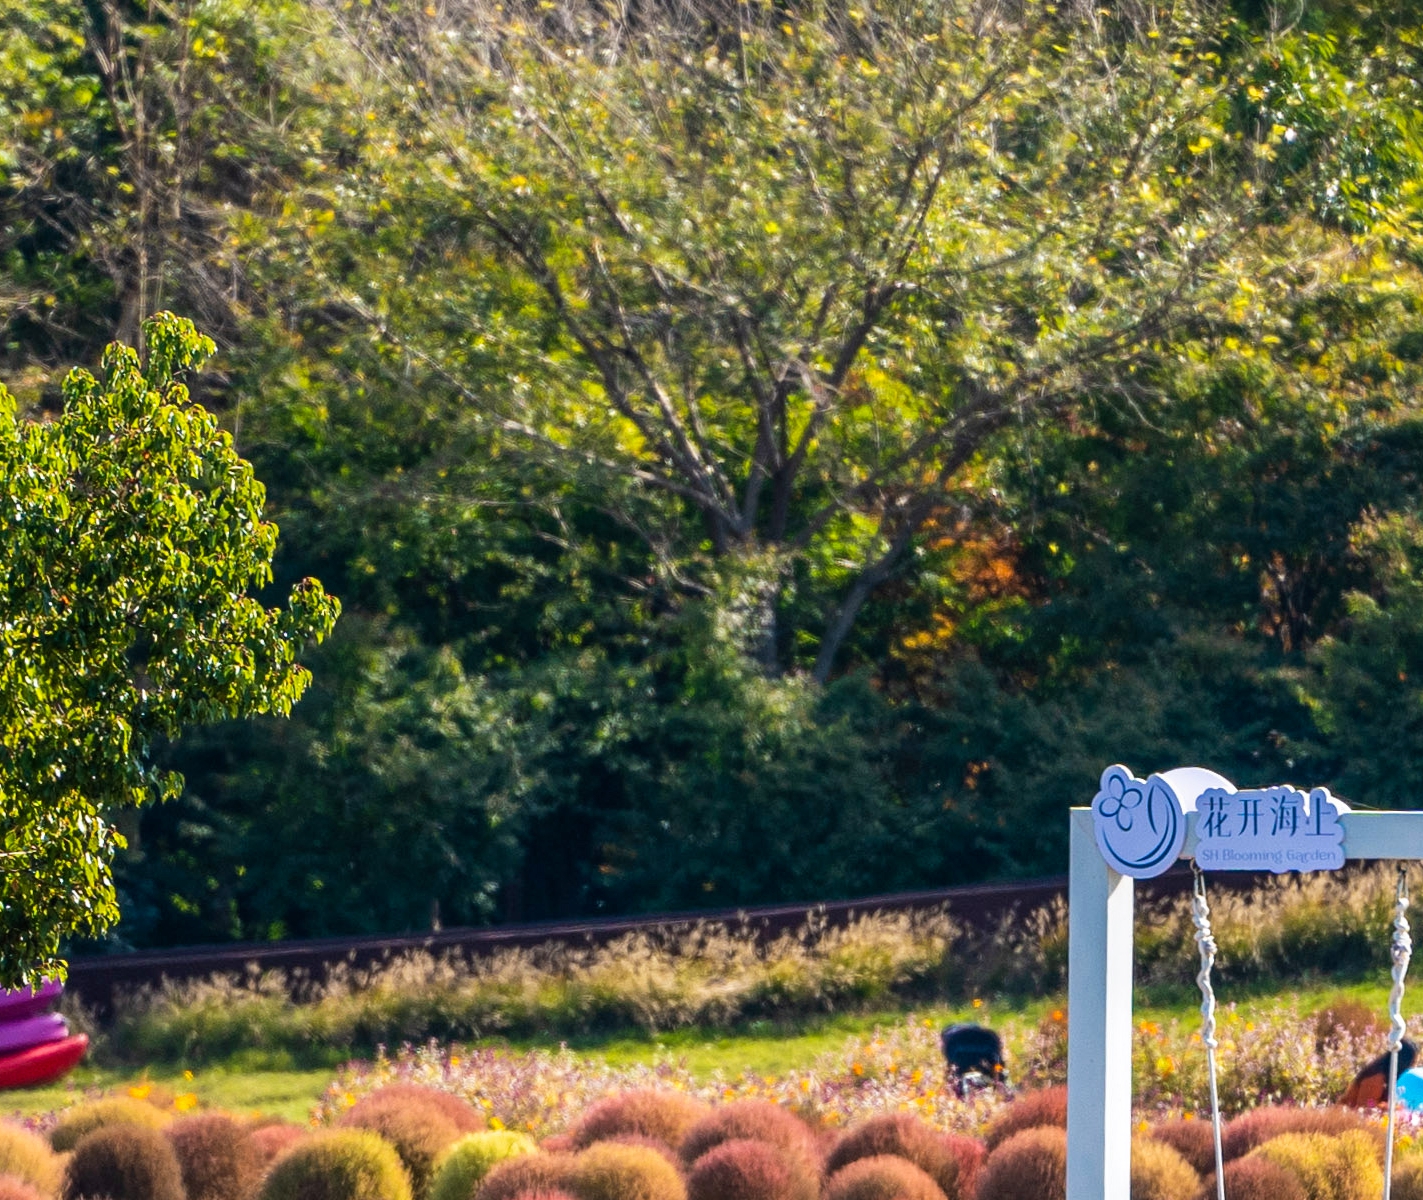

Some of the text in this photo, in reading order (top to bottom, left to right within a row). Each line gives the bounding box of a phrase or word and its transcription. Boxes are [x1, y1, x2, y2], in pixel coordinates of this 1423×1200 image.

[1202, 796, 1335, 838] 花开海上
[1222, 850, 1281, 864] Blooming
[1286, 850, 1335, 863] Garden
